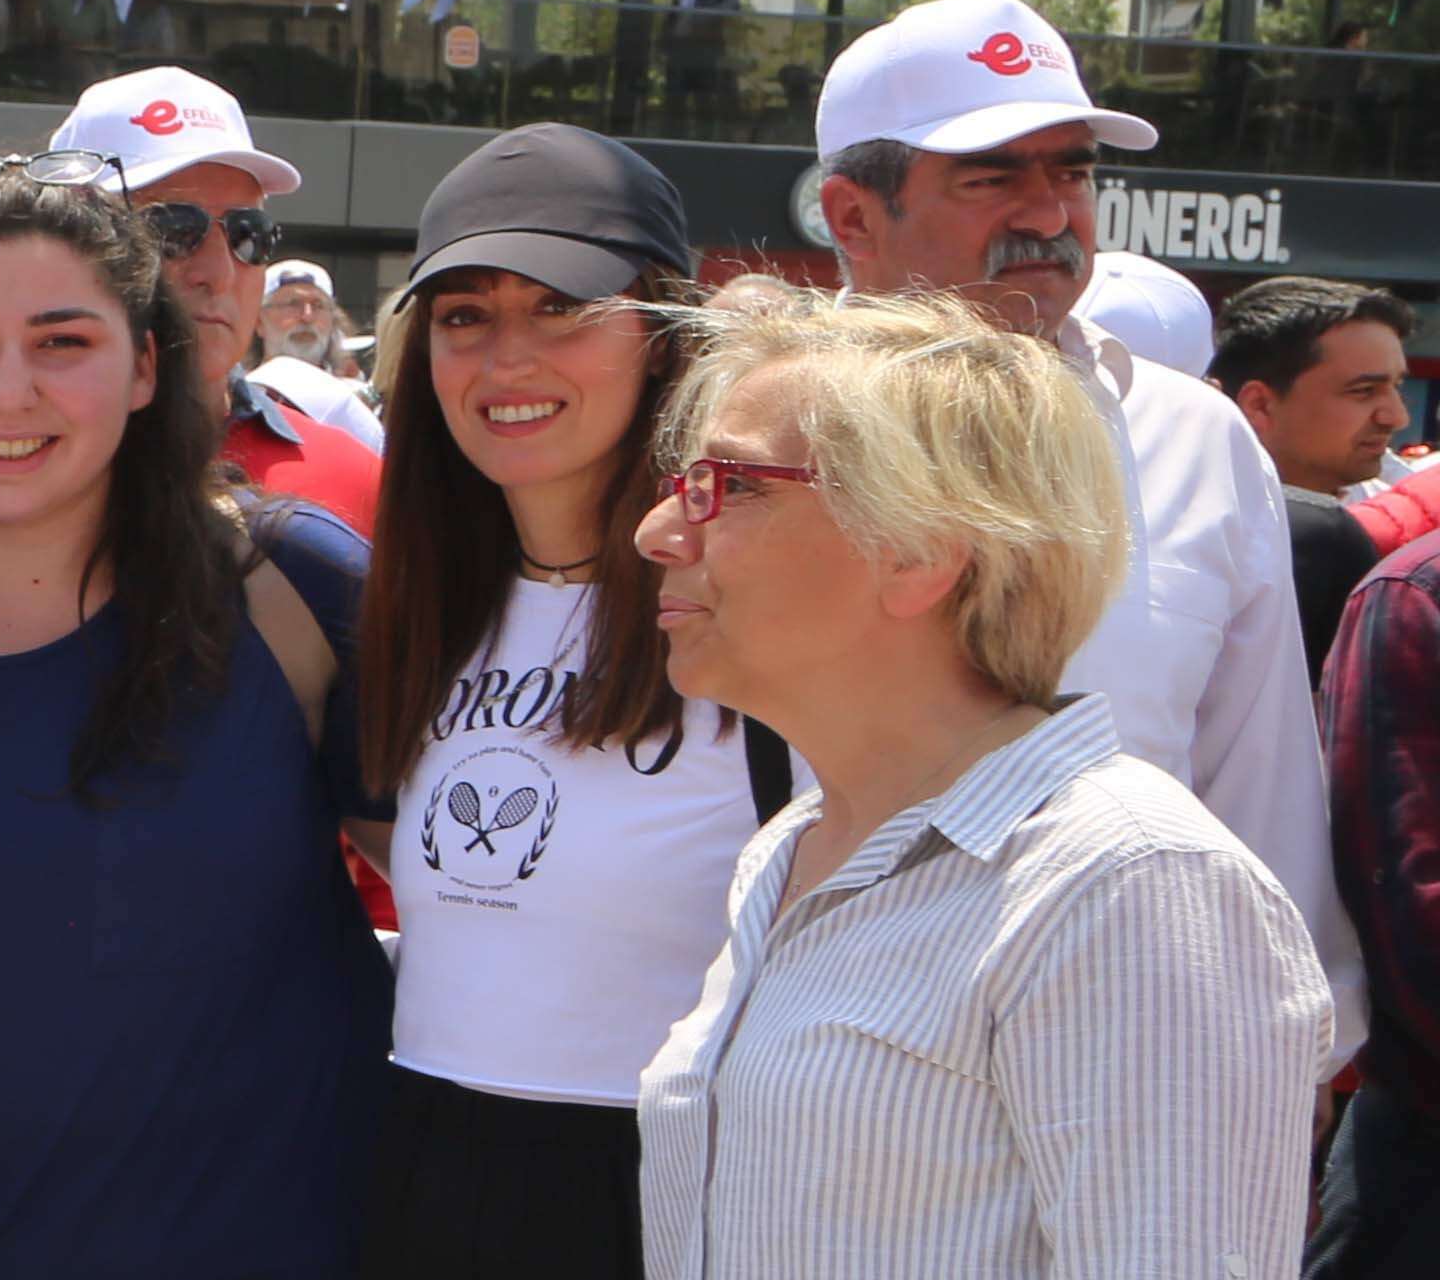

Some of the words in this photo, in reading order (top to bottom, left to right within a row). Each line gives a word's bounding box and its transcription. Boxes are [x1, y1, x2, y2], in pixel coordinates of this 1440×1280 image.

[1096, 177, 1285, 264] ÖNERCİ
[436, 890, 475, 906] Tennis
[476, 895, 518, 911] season
